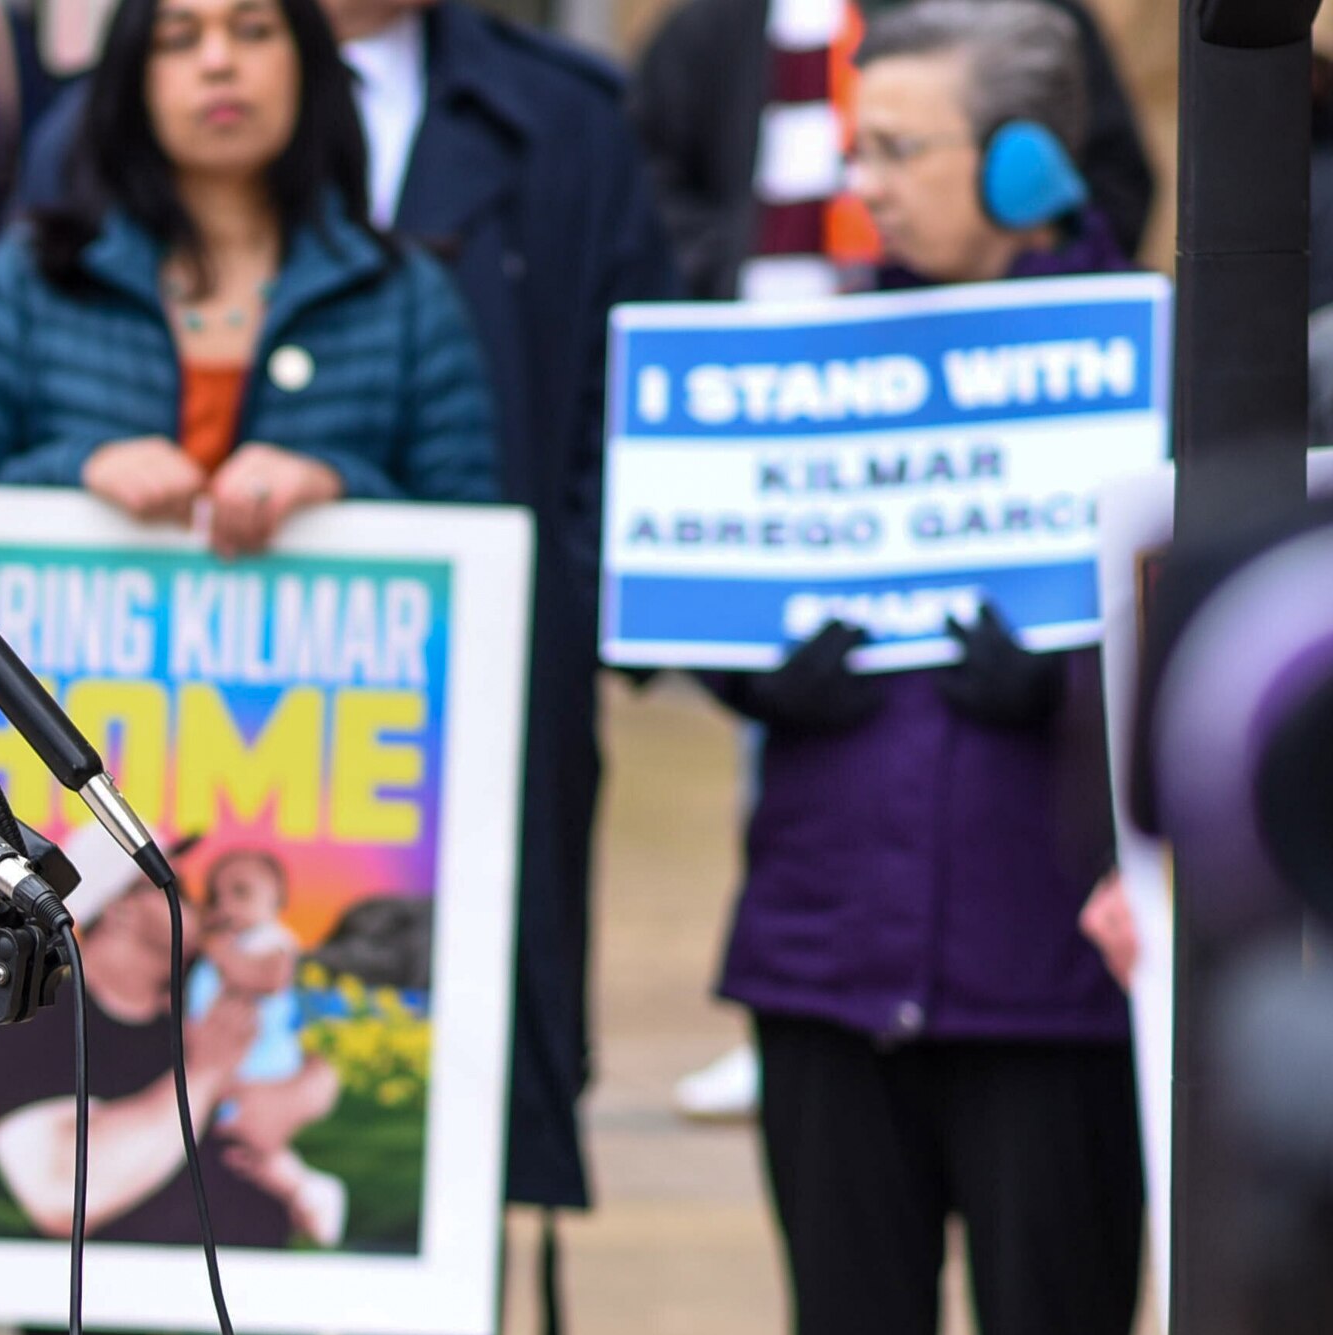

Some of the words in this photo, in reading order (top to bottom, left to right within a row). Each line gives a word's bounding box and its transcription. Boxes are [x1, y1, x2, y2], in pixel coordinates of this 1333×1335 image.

[637, 364, 670, 425] I
[684, 353, 930, 426] STAND
[944, 336, 1137, 409] WITH
[757, 444, 1006, 495] KILMAR
[629, 508, 881, 551] ABREGO
[169, 568, 430, 684] KILMAR
